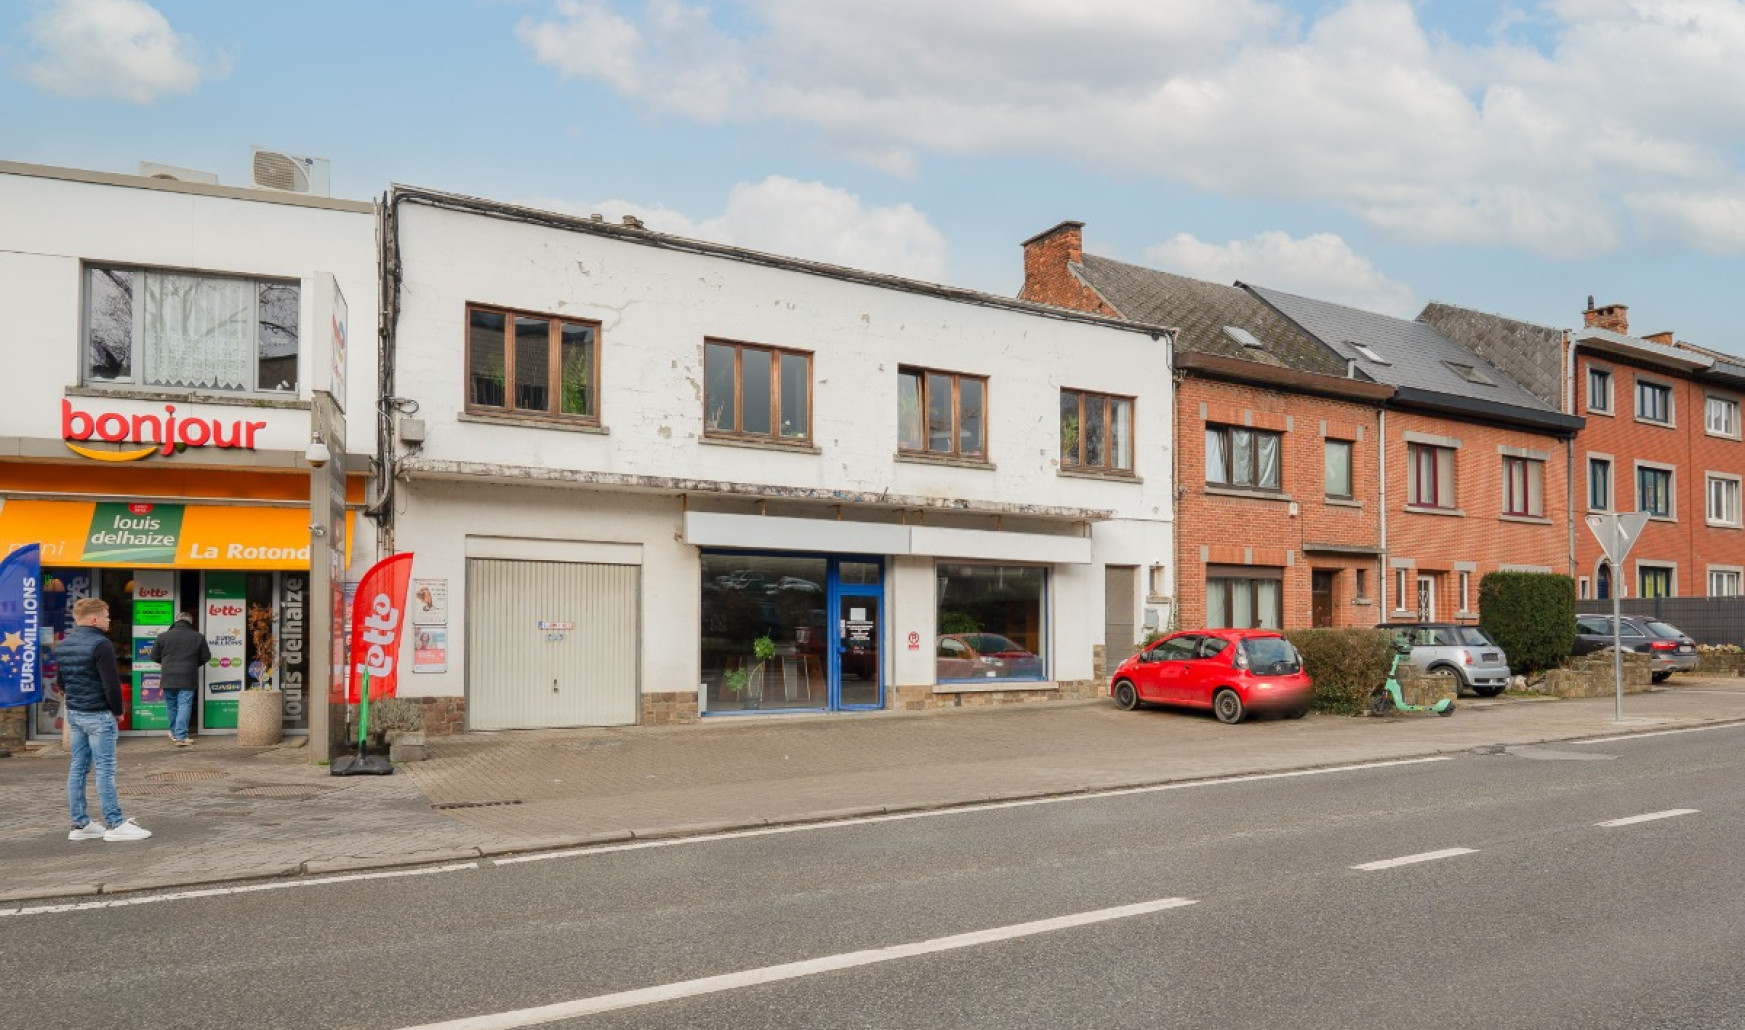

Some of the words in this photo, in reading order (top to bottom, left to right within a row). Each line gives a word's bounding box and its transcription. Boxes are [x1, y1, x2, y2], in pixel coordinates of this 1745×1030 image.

[61, 398, 267, 457] bonjour
[90, 530, 175, 546] delhaize
[113, 514, 161, 530] louis
[190, 543, 219, 559] La
[20, 576, 38, 692] EUROMILLIONS
[280, 577, 304, 665] delhaize
[280, 671, 303, 721] louis
